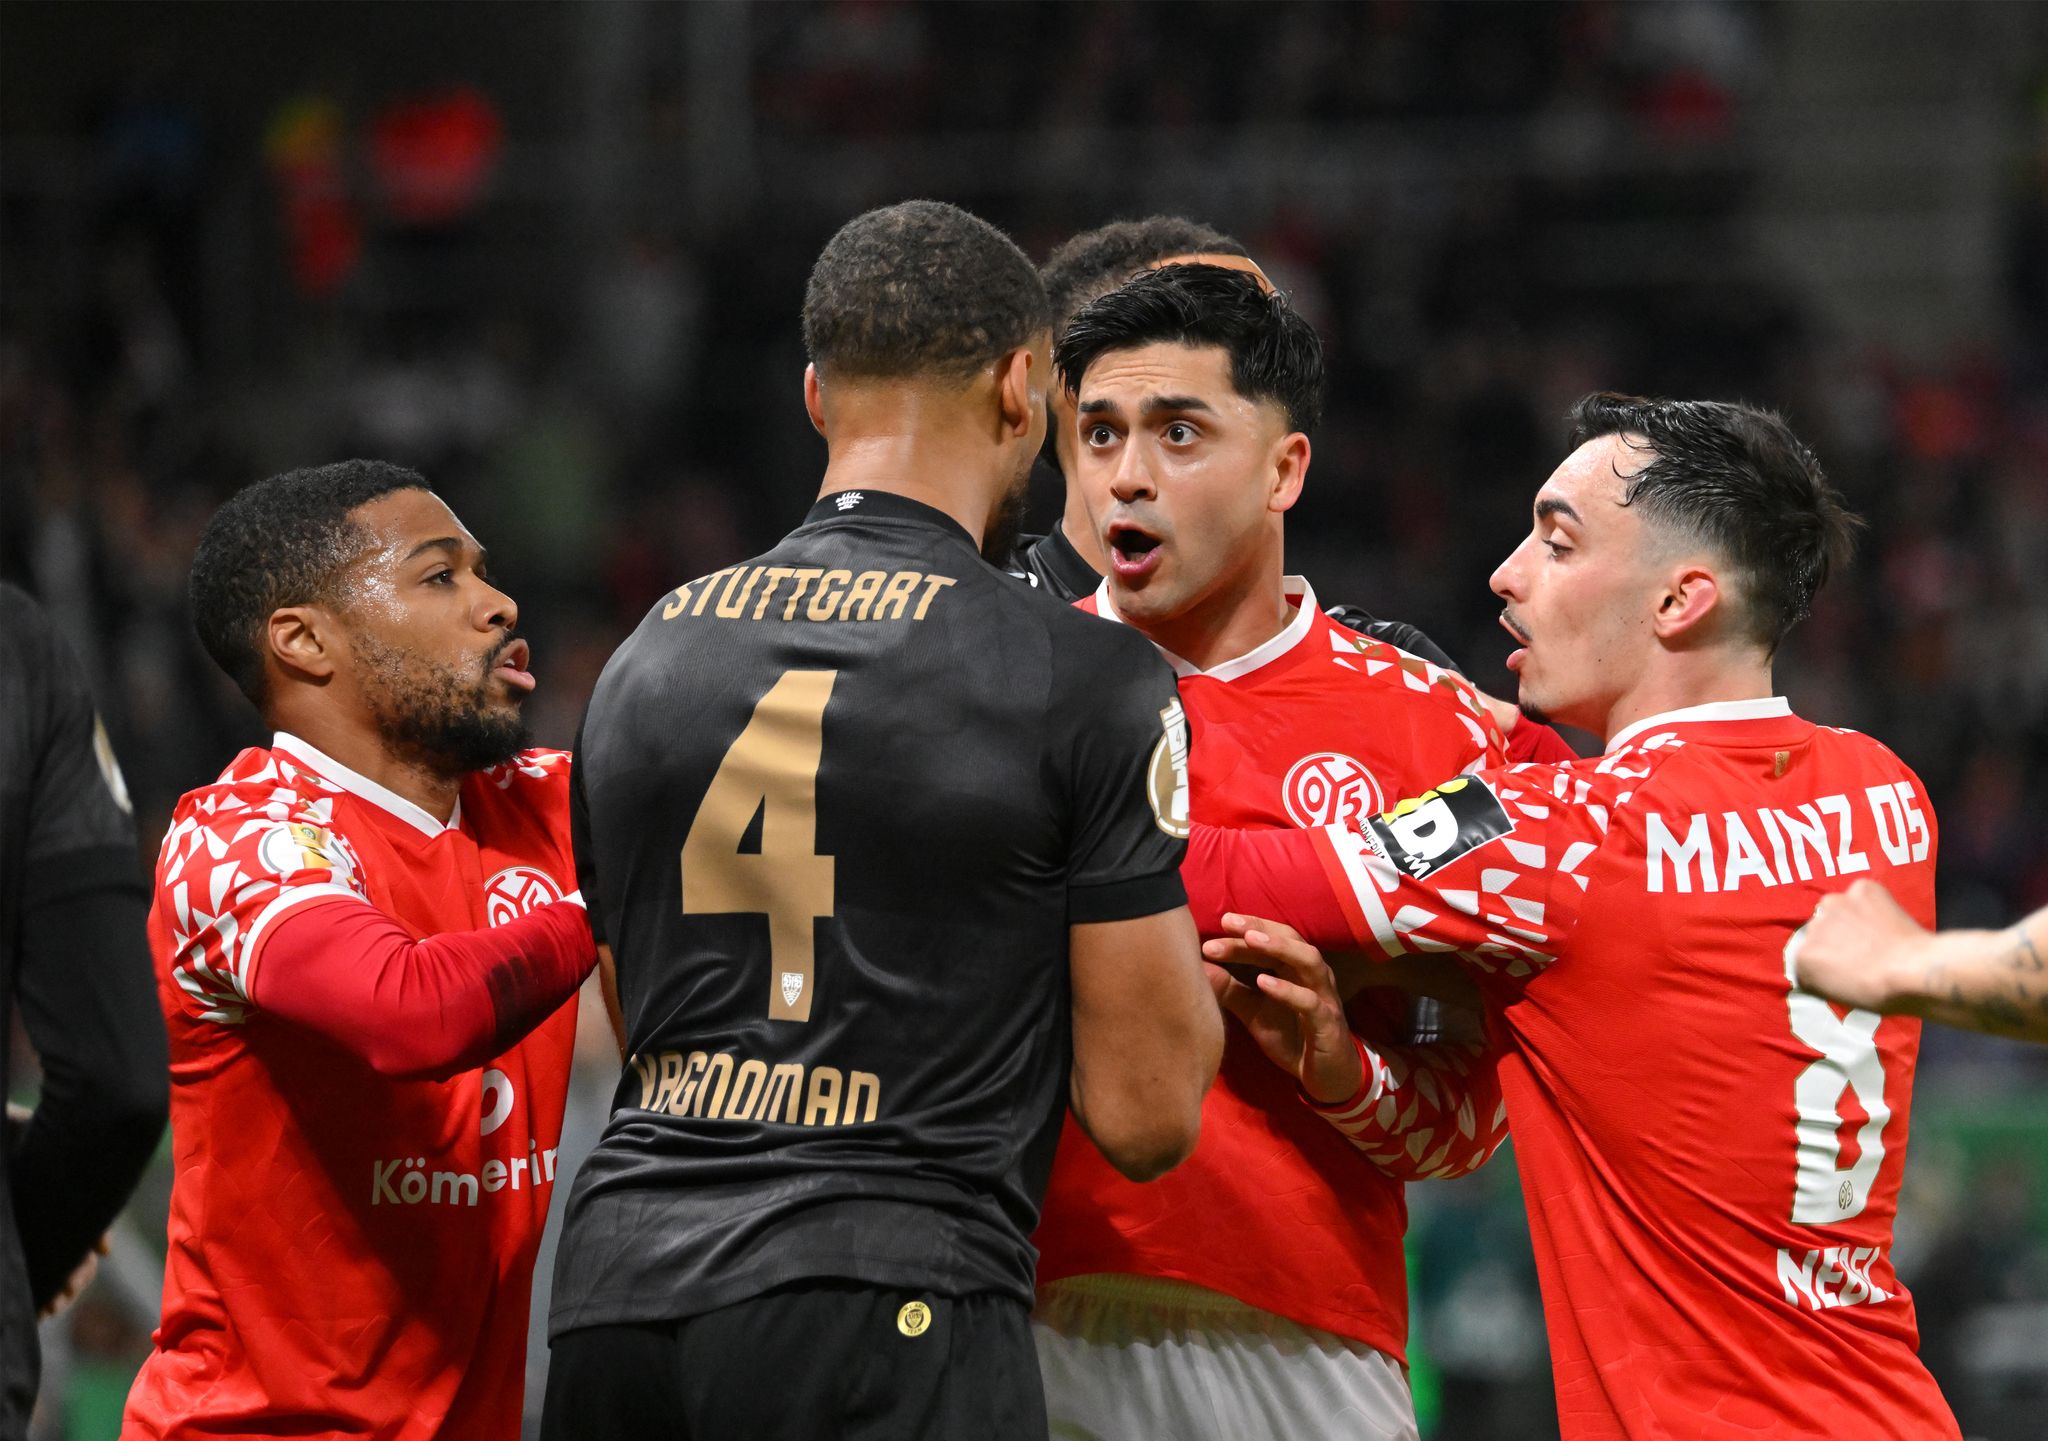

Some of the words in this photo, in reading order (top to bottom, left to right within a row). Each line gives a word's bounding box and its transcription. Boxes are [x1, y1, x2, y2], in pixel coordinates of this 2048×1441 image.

[662, 566, 958, 621] STUTTGART
[681, 670, 838, 1022] 4
[1646, 793, 1871, 893] MAINZ
[1864, 780, 1931, 866] 05
[631, 1050, 880, 1126] VAGNOMAN
[1783, 925, 1892, 1225] 8
[1776, 1246, 1895, 1311] NEBEL
